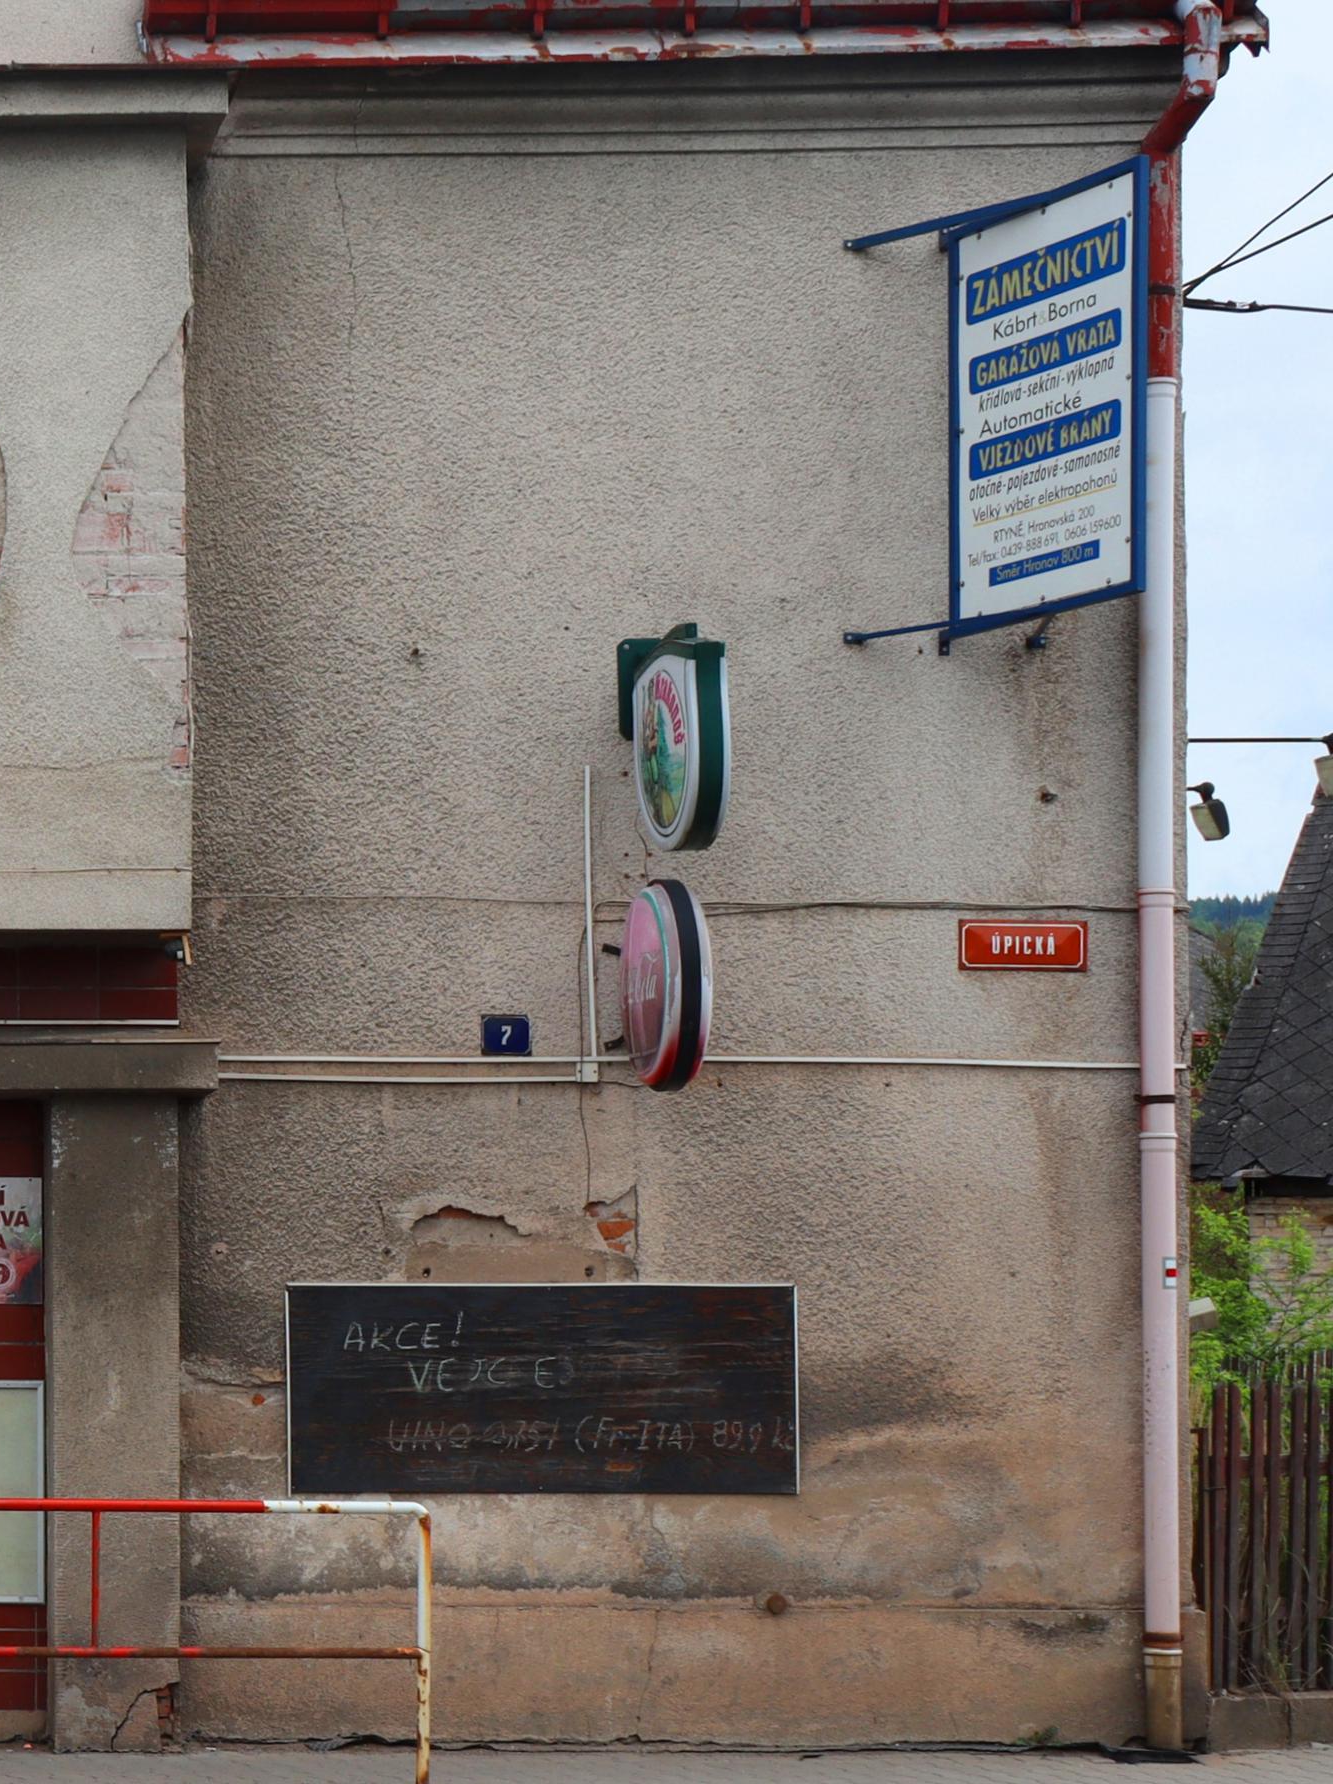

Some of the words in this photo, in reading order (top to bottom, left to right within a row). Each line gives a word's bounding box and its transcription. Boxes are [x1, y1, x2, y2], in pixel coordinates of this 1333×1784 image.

[972, 219, 1121, 317] ZÁMEČNICTVÍ
[993, 311, 1037, 341] Kábrt
[1048, 294, 1097, 321] Borna
[976, 332, 1061, 387] GARÁŽOVÁ
[1066, 318, 1116, 357] VRATA
[979, 390, 1082, 438] Automatické
[978, 421, 1055, 472] VJEZDOVÉ
[1060, 410, 1113, 448] BRÁNY
[973, 505, 1002, 522] Velký
[1005, 495, 1035, 516] výběr
[1038, 468, 1118, 505] elektropohonů
[1028, 511, 1075, 534] Hronovská
[1078, 505, 1095, 520] 200
[996, 566, 1021, 581] Směr
[1023, 556, 1059, 574] Hronov
[1061, 546, 1082, 561] 800
[991, 931, 1056, 955] ÚPICKÁ
[501, 1025, 512, 1046] 7
[343, 1311, 464, 1352] AKCE!
